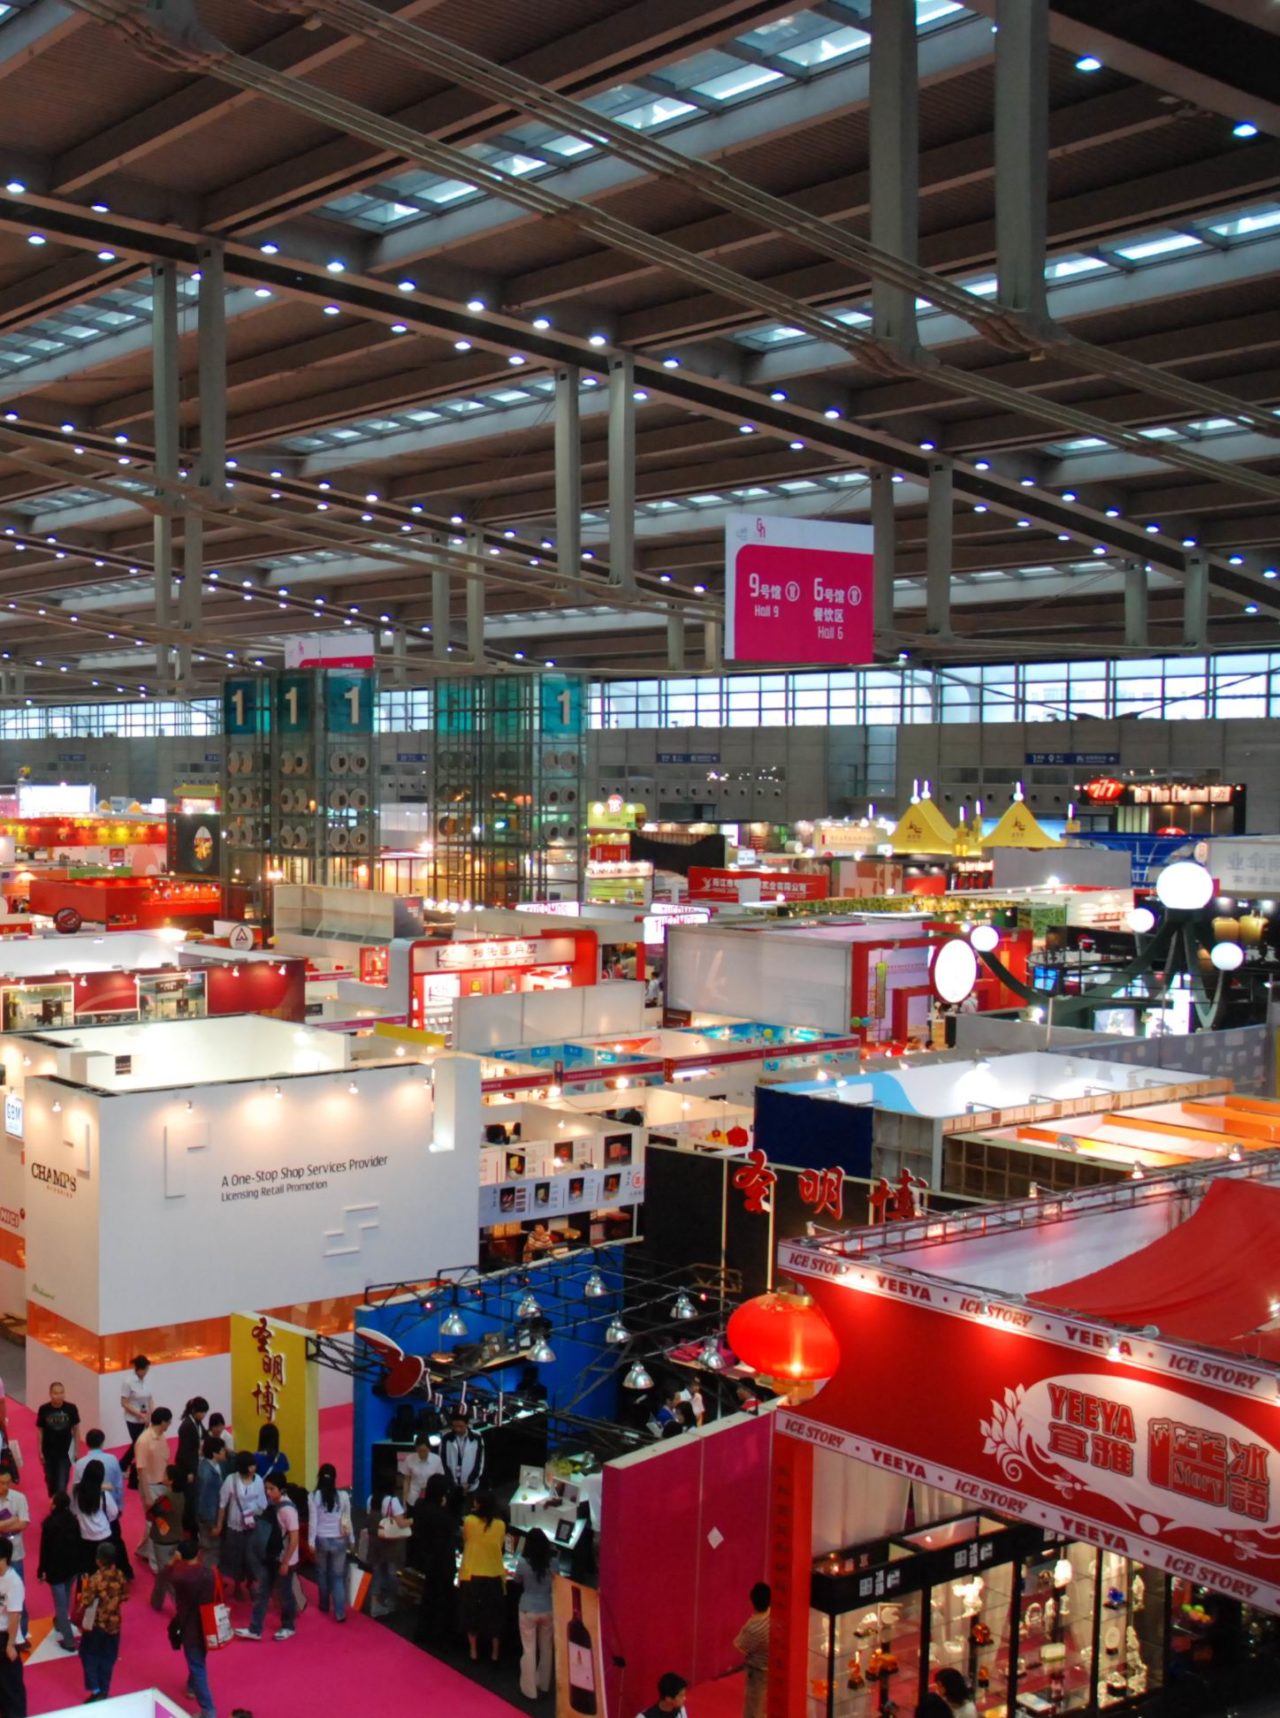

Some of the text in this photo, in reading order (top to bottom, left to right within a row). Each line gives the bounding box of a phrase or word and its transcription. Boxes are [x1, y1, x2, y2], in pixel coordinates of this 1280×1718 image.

[344, 686, 359, 725] 1
[557, 688, 570, 726] 1
[31, 1161, 77, 1193] CHAMPS
[221, 1154, 389, 1187] A One-Stop Shop Services Provider
[220, 1180, 328, 1203] Licensing Retail Promotion
[788, 1252, 810, 1268] ICE
[876, 1275, 932, 1302] YEEYA
[987, 1304, 1034, 1328] STORY
[1168, 1353, 1197, 1372] ICE
[1199, 1358, 1261, 1390] STORY
[1047, 1382, 1137, 1443] YEEYA
[784, 1418, 805, 1436] ICE
[805, 1424, 845, 1448] STORY
[871, 1448, 927, 1479] YEEYA
[955, 1479, 980, 1498] ICE
[980, 1486, 1028, 1514] STORY
[1060, 1515, 1129, 1553] YEEYA
[1164, 1555, 1196, 1577] ICE
[1197, 1568, 1259, 1599] STORY
